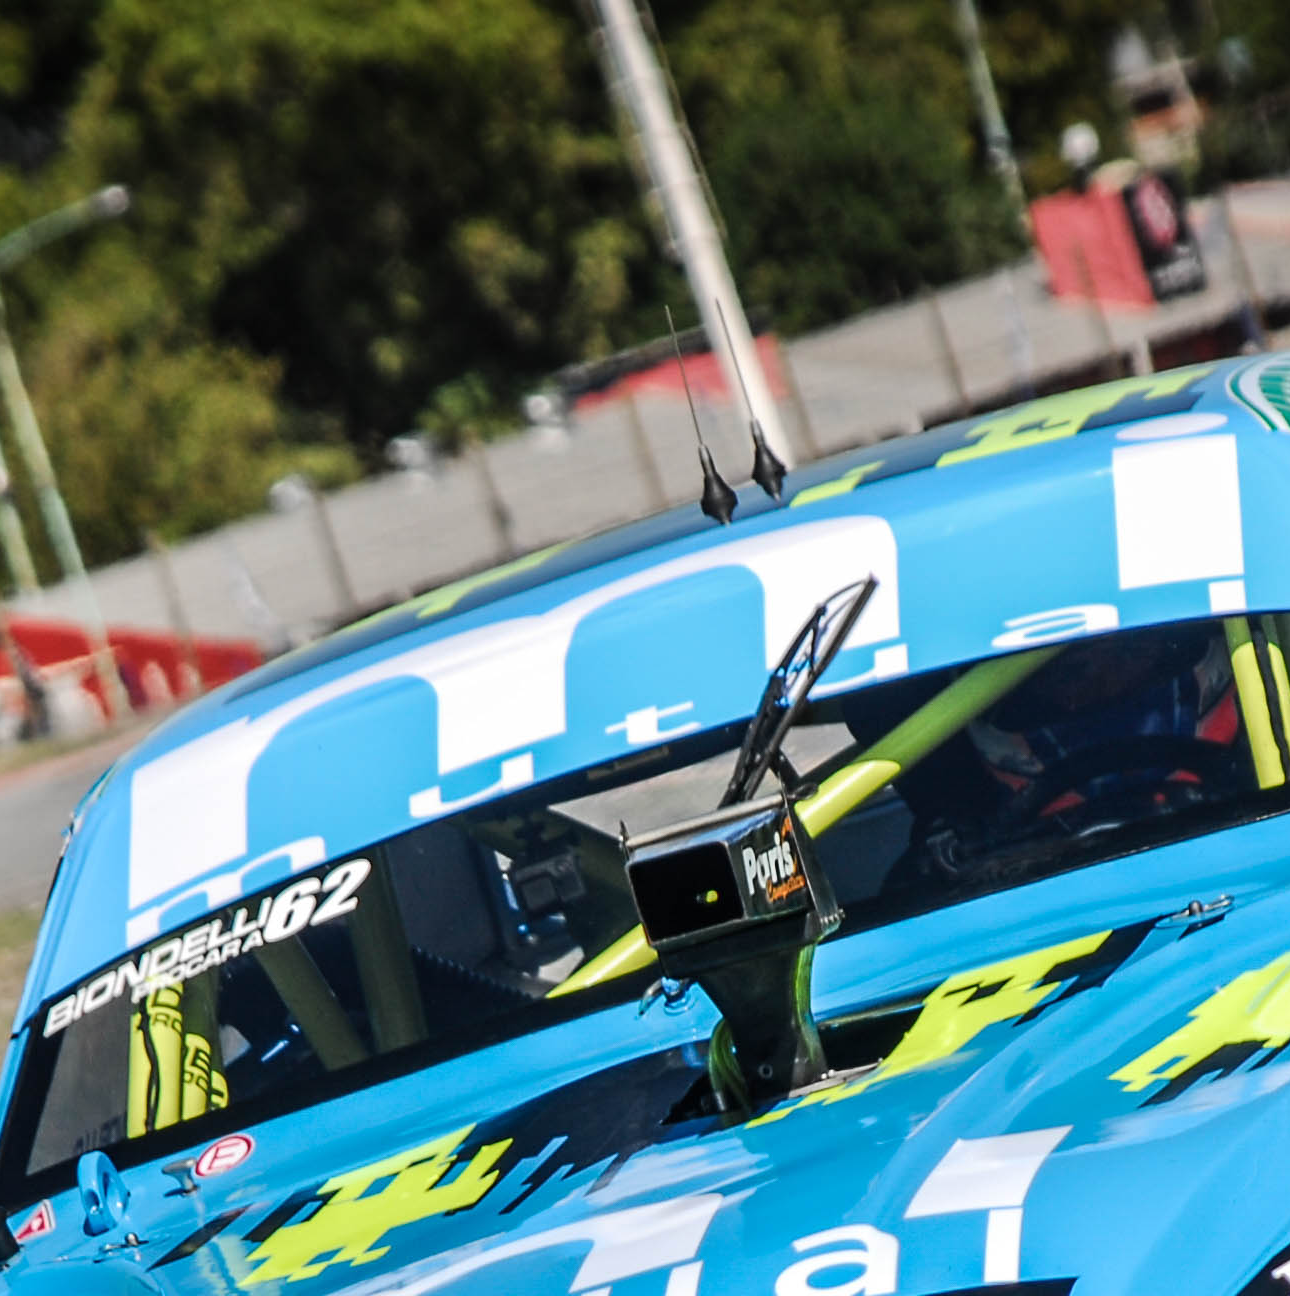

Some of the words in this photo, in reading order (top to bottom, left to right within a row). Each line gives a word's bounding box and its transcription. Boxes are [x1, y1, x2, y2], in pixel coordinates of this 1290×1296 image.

[741, 831, 794, 896] Paris
[43, 897, 272, 1039] BIONDELLI
[261, 858, 372, 943] 62
